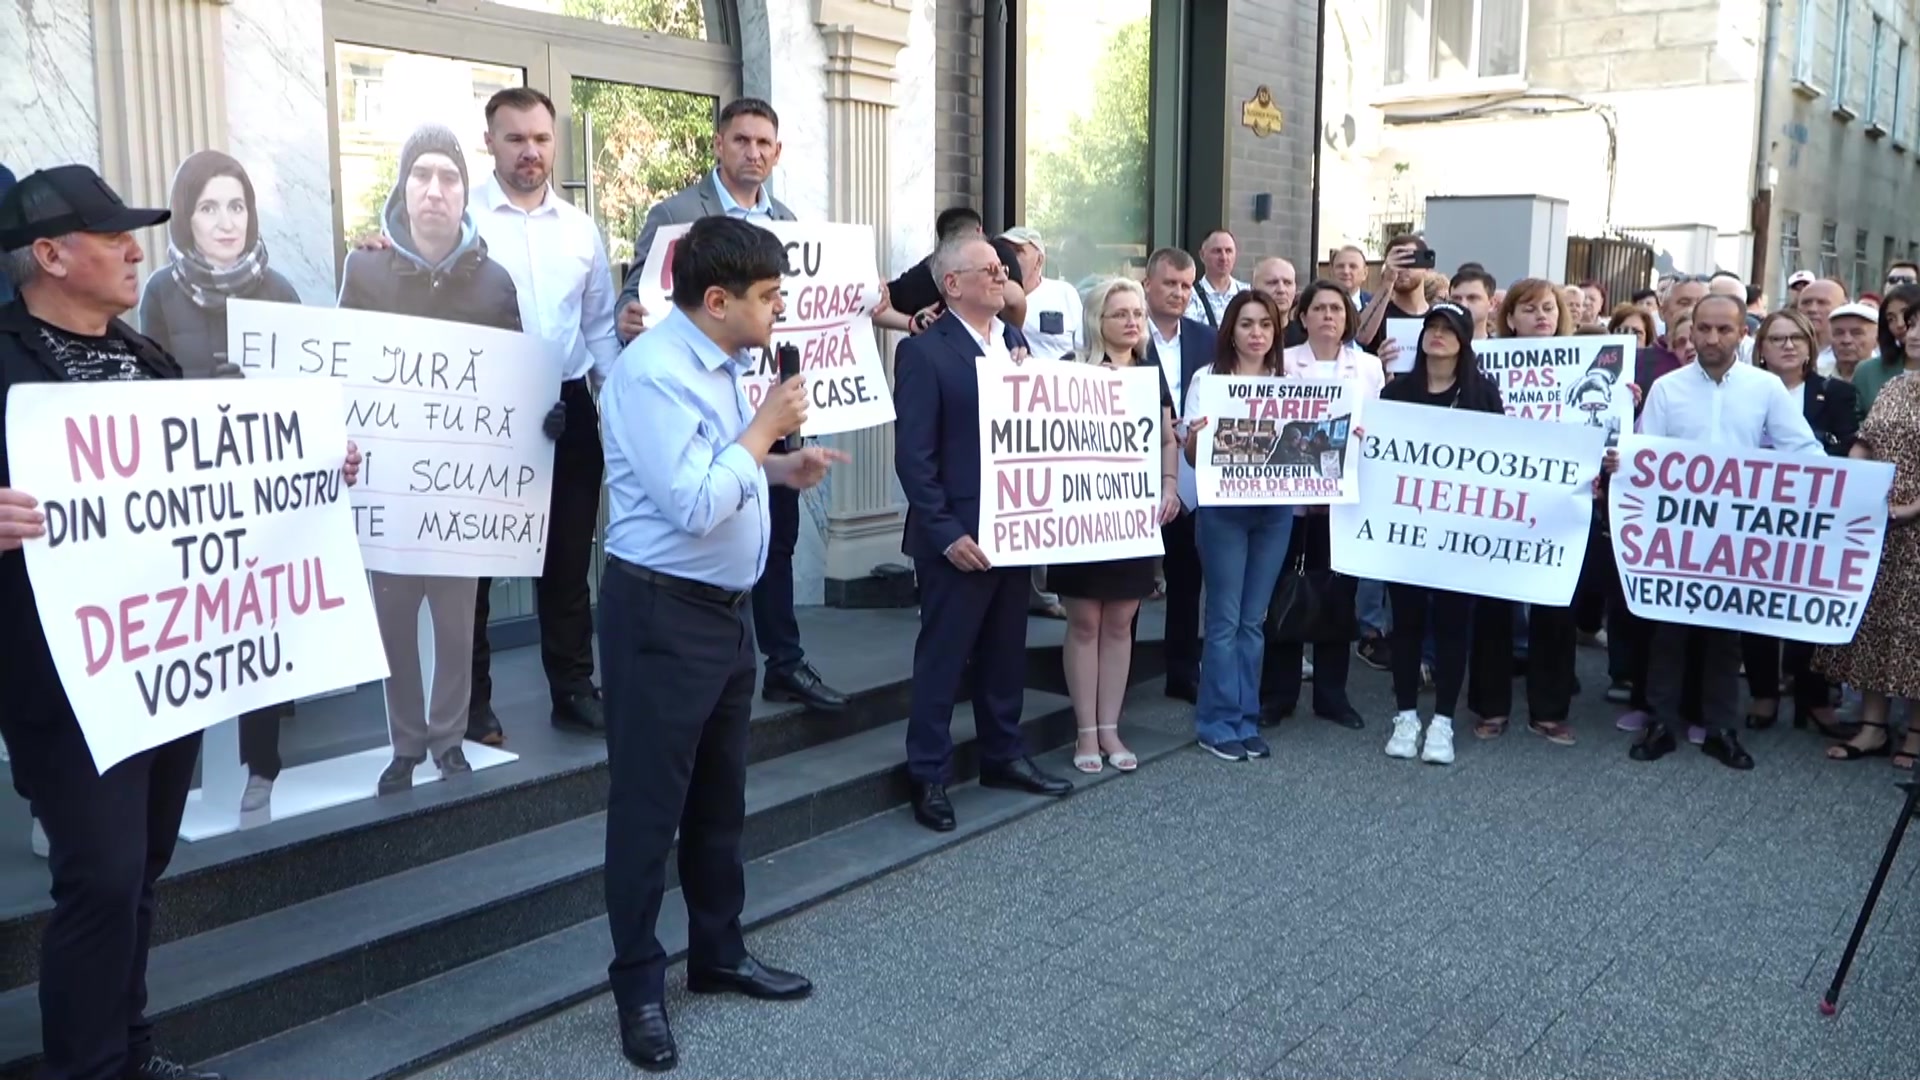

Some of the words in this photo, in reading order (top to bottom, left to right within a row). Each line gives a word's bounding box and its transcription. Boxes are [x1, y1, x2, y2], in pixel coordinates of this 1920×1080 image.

[797, 283, 866, 321] GRASE,
[242, 332, 277, 370] EI
[299, 339, 351, 377] SE
[372, 346, 484, 393] JURĂ
[801, 326, 857, 372] FĂRĂ
[813, 376, 879, 409] CASE.
[1002, 374, 1126, 415] TALOANE
[1228, 384, 1252, 398] VOI
[1256, 384, 1275, 398] NE
[1278, 384, 1342, 403] STABILIȚI
[1508, 367, 1561, 389] PAS,
[1548, 390, 1561, 402] DE
[346, 400, 400, 430] NU
[424, 402, 516, 439] FURĂ
[1245, 398, 1332, 420] TARIF,
[65, 413, 141, 482] NU
[161, 403, 304, 473] PLĂTIM
[991, 416, 1154, 454] MILIONARILOR?
[410, 459, 535, 498] SCUMP
[1221, 465, 1312, 479] MOLDOVENII
[1362, 434, 1579, 485] ЗАМОРОЗЬТЕ
[1629, 449, 1848, 509] SCOATEȚI
[997, 467, 1052, 511] NU
[1062, 472, 1092, 503] DIN
[1096, 471, 1155, 501] CONTUL
[1219, 478, 1261, 492] MOR
[1265, 478, 1289, 492] DE
[1294, 478, 1338, 491] FRIG!
[1392, 474, 1537, 528] ЦЕНЫ,
[44, 496, 107, 548] DIN
[124, 481, 245, 534] CONTUL
[253, 468, 342, 516] NOSTRU
[993, 504, 1157, 553] PENSIONARILOR!
[1656, 495, 1718, 528] DIN
[1731, 503, 1835, 540] TARIF
[171, 528, 247, 579] TOT
[417, 511, 546, 554] MĂSURĂ!
[1356, 518, 1374, 541] А
[1386, 522, 1427, 548] НЕ
[1438, 530, 1565, 567] ЛЮДЕЙ!
[1620, 523, 1870, 593] SALARIILE
[75, 556, 345, 677] DEZMĂȚUL
[1624, 573, 1858, 628] VERIȘOARELOR!
[135, 632, 294, 717] VOSTRU.
